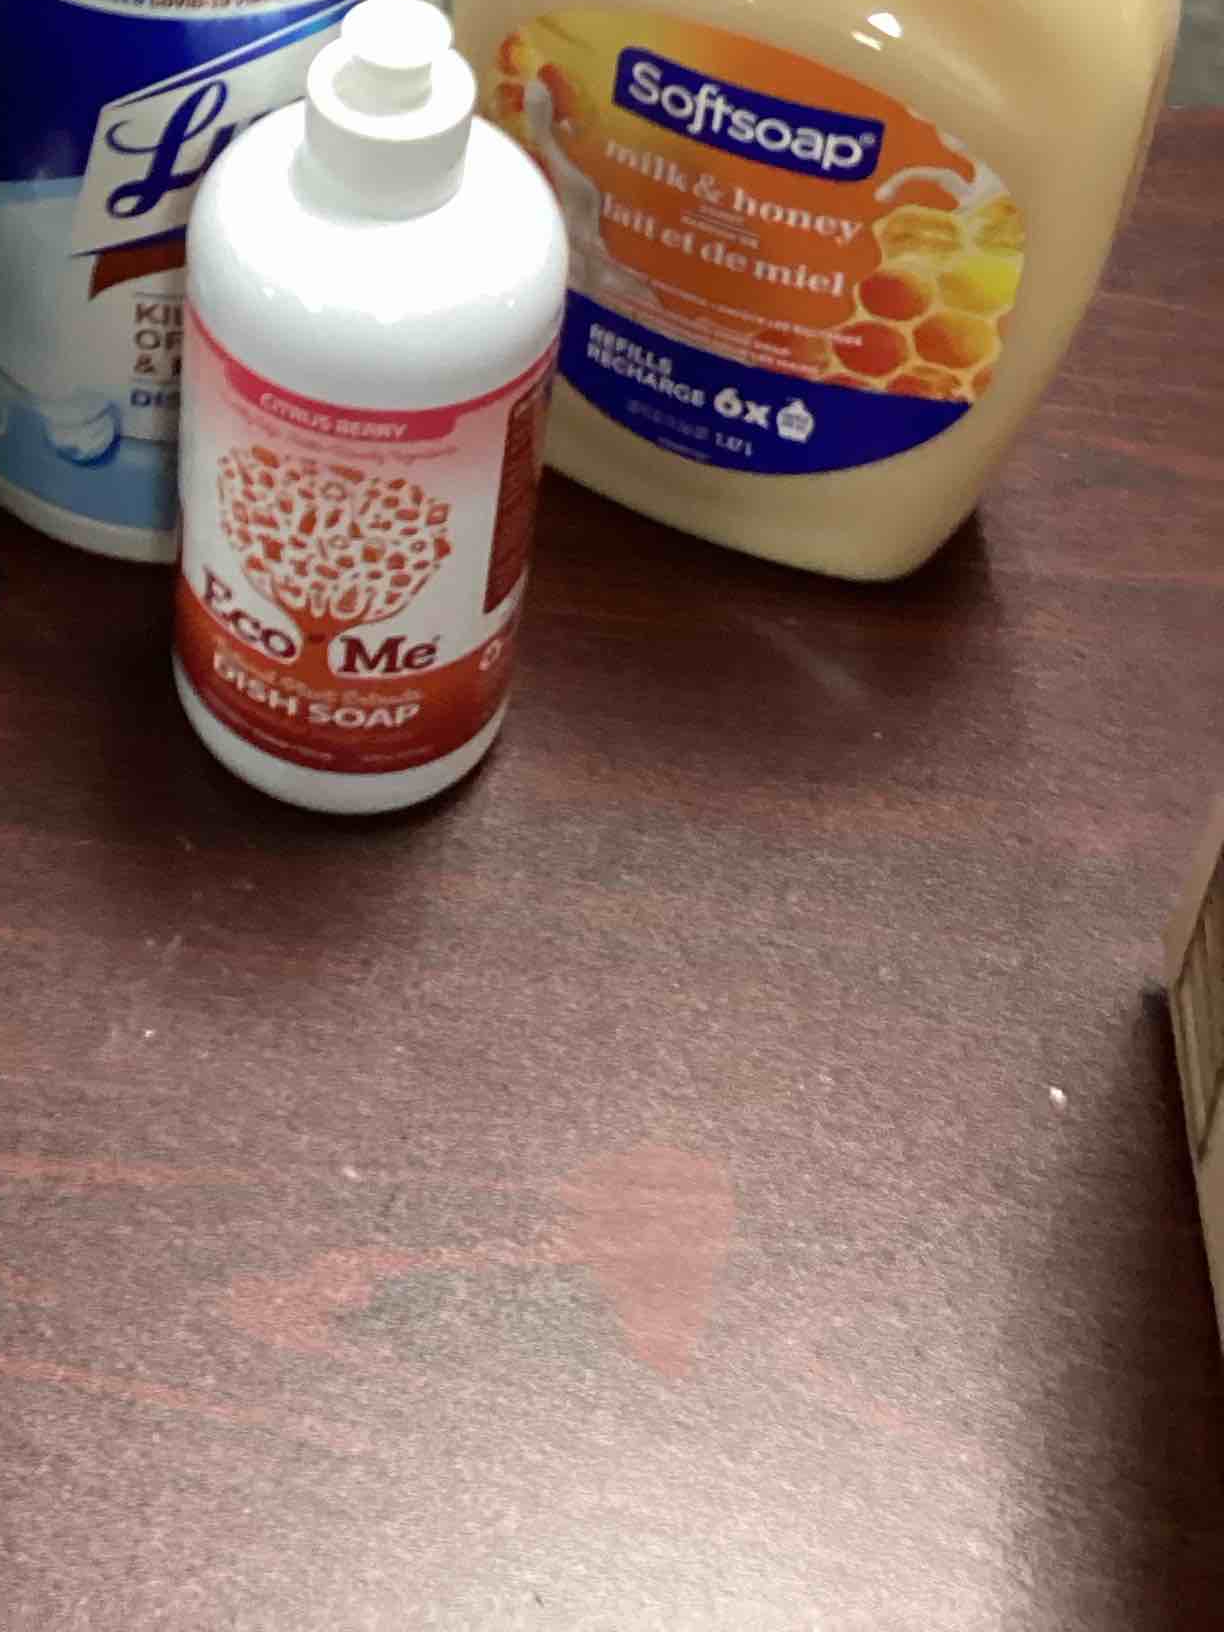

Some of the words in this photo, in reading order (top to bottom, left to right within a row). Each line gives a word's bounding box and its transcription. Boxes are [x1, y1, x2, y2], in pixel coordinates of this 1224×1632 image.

[604, 139, 688, 193] milk
[691, 173, 723, 204] &
[733, 187, 862, 248] honey
[602, 191, 659, 240] lait
[660, 227, 694, 255] et
[700, 242, 749, 272] de
[753, 259, 846, 298] miel
[586, 341, 706, 409] RECHARGE
[588, 323, 673, 376] REFILLS
[259, 392, 333, 431] CITRUS
[202, 565, 296, 659] Eco
[338, 634, 438, 675] Me
[213, 650, 299, 718] DISH
[307, 703, 421, 729] SOAP
